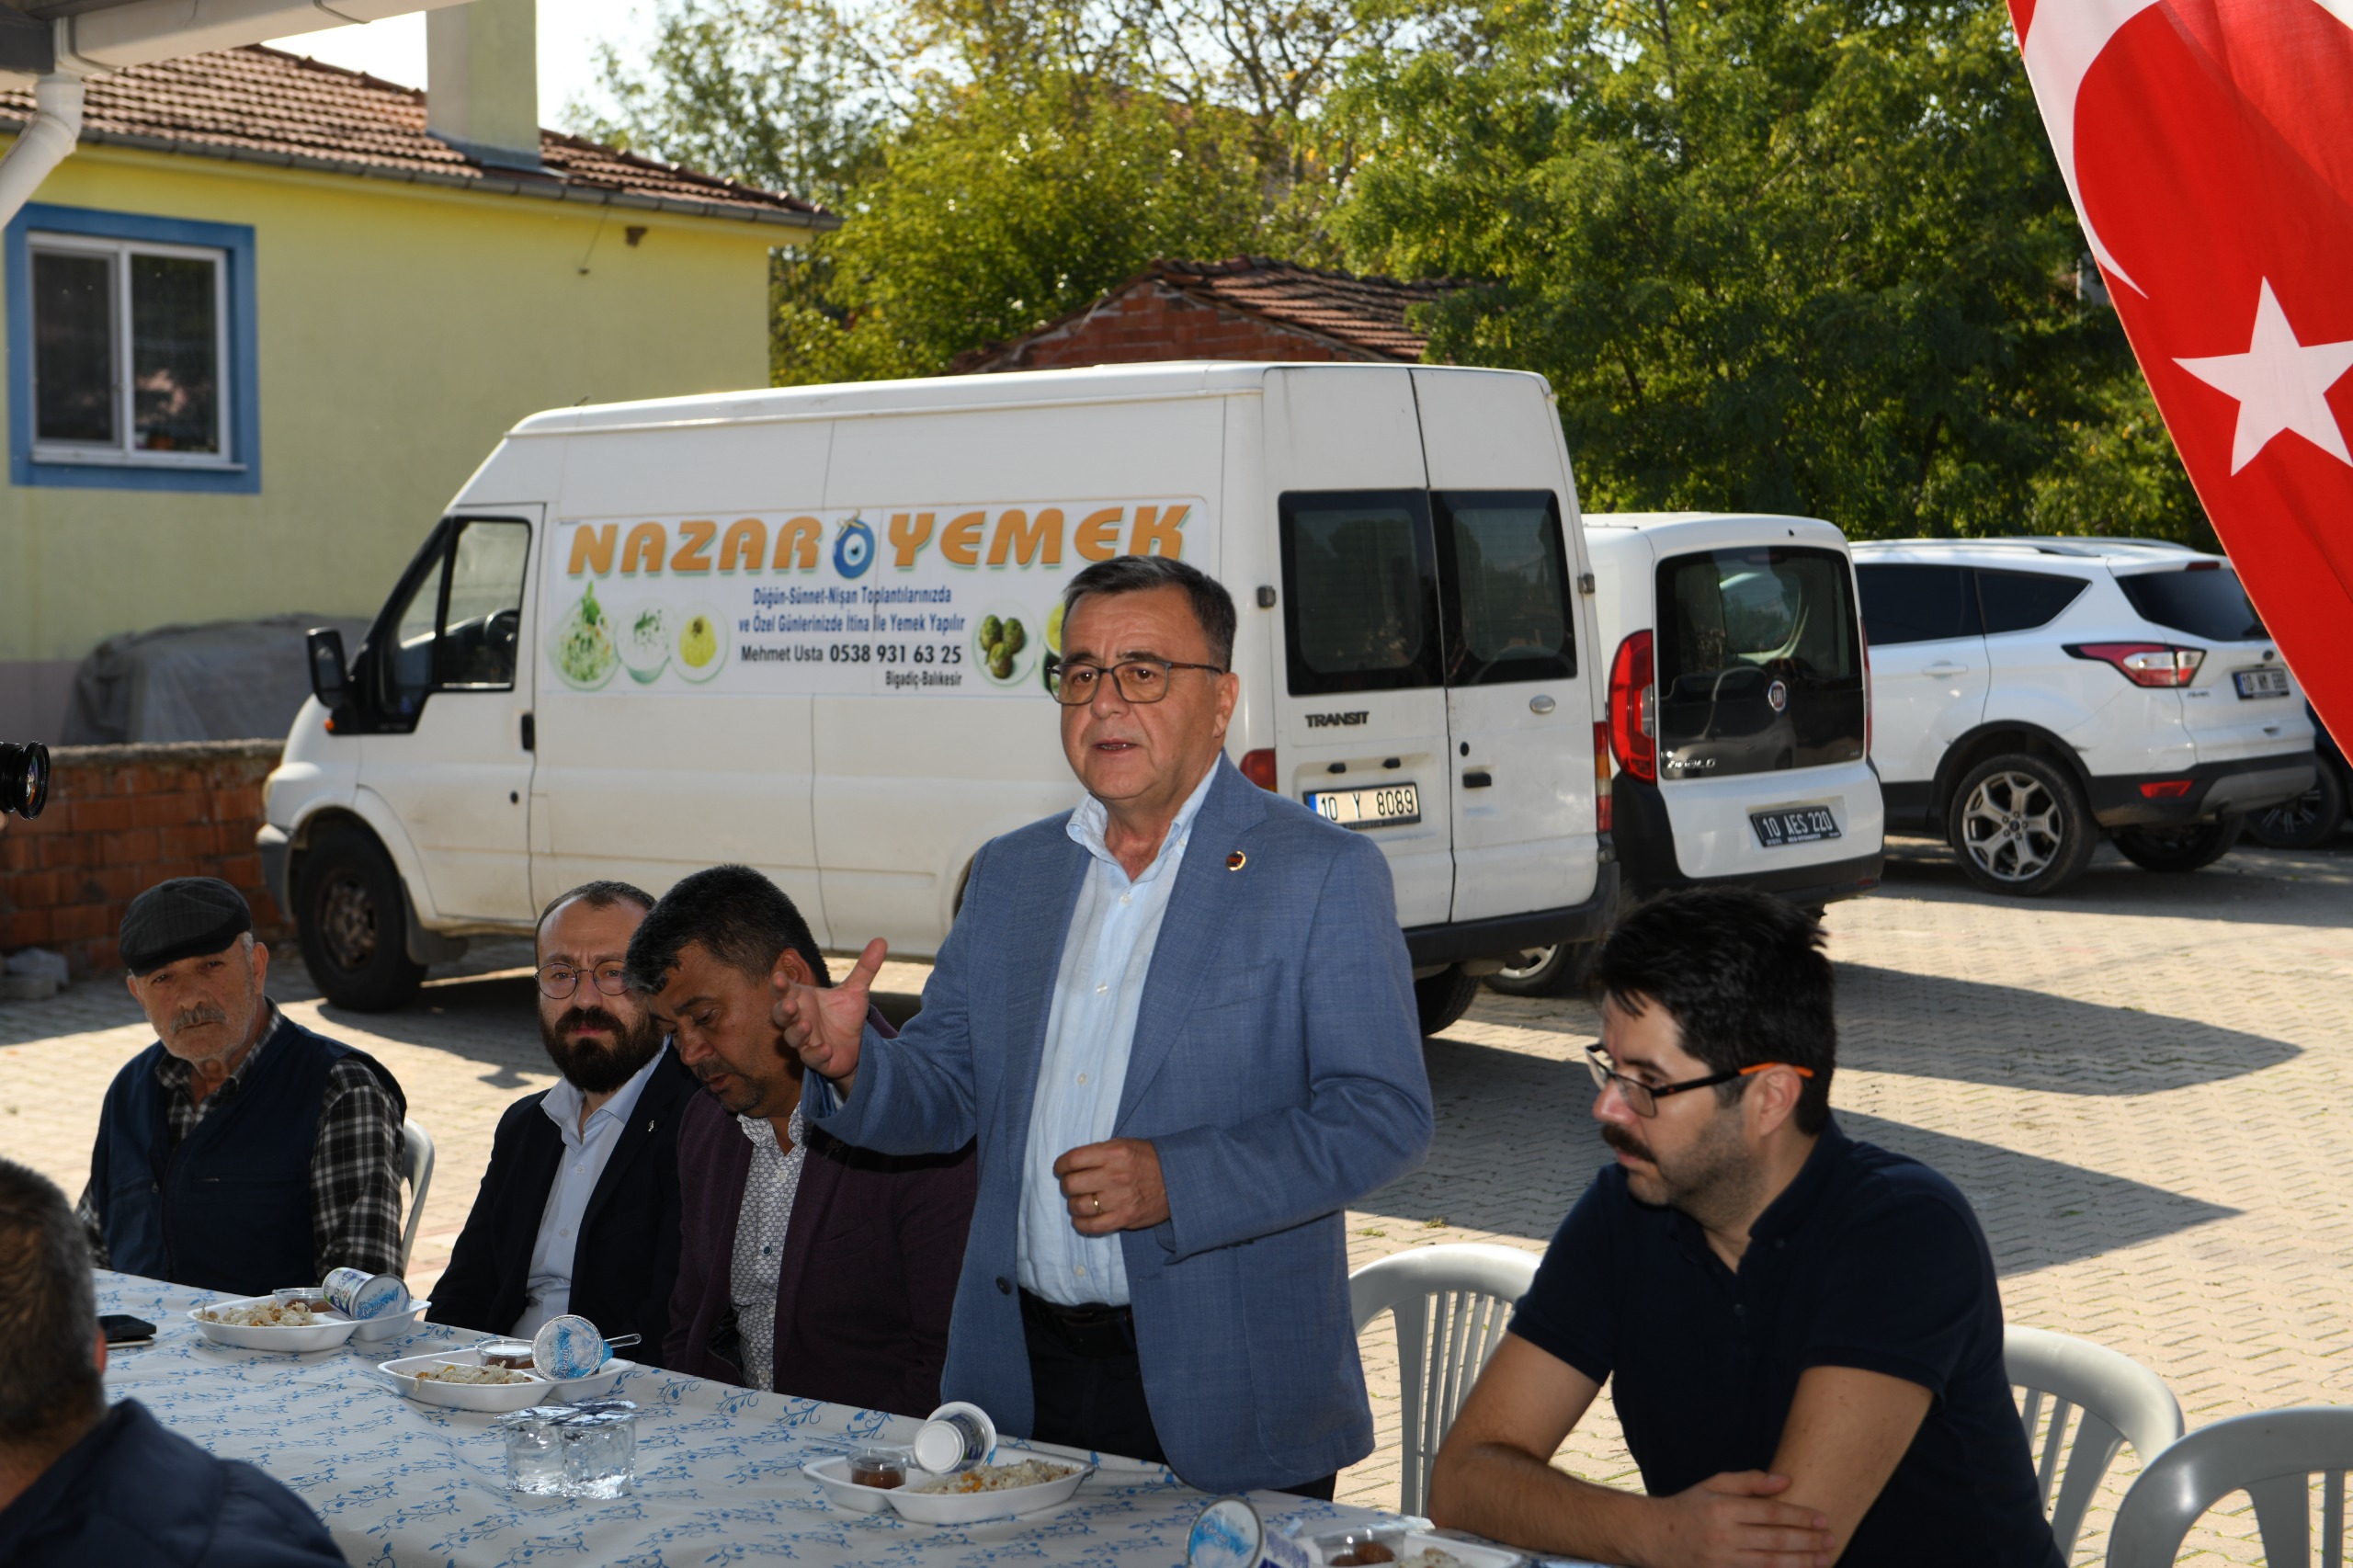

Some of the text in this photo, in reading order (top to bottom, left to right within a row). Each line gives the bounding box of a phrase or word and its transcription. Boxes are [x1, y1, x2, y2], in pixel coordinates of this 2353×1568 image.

[567, 505, 1192, 576] NAZAR YEMEK
[753, 585, 952, 609] Düğün-Sünnet-Nişan Toplantılarınızda
[738, 618, 750, 632] ve
[753, 610, 776, 632] Özel
[779, 614, 843, 632] Günlerinizde
[890, 613, 926, 632] Yemek
[929, 613, 965, 636] Yapılır
[741, 644, 962, 664] Mehmet Usta 0538 931 63 25
[885, 670, 962, 689] Bigadiç-Balıkesir
[1305, 711, 1370, 728] TRANSIT
[1321, 790, 1414, 821] 10 Y 8089
[1763, 811, 1833, 837] 10 AES 220
